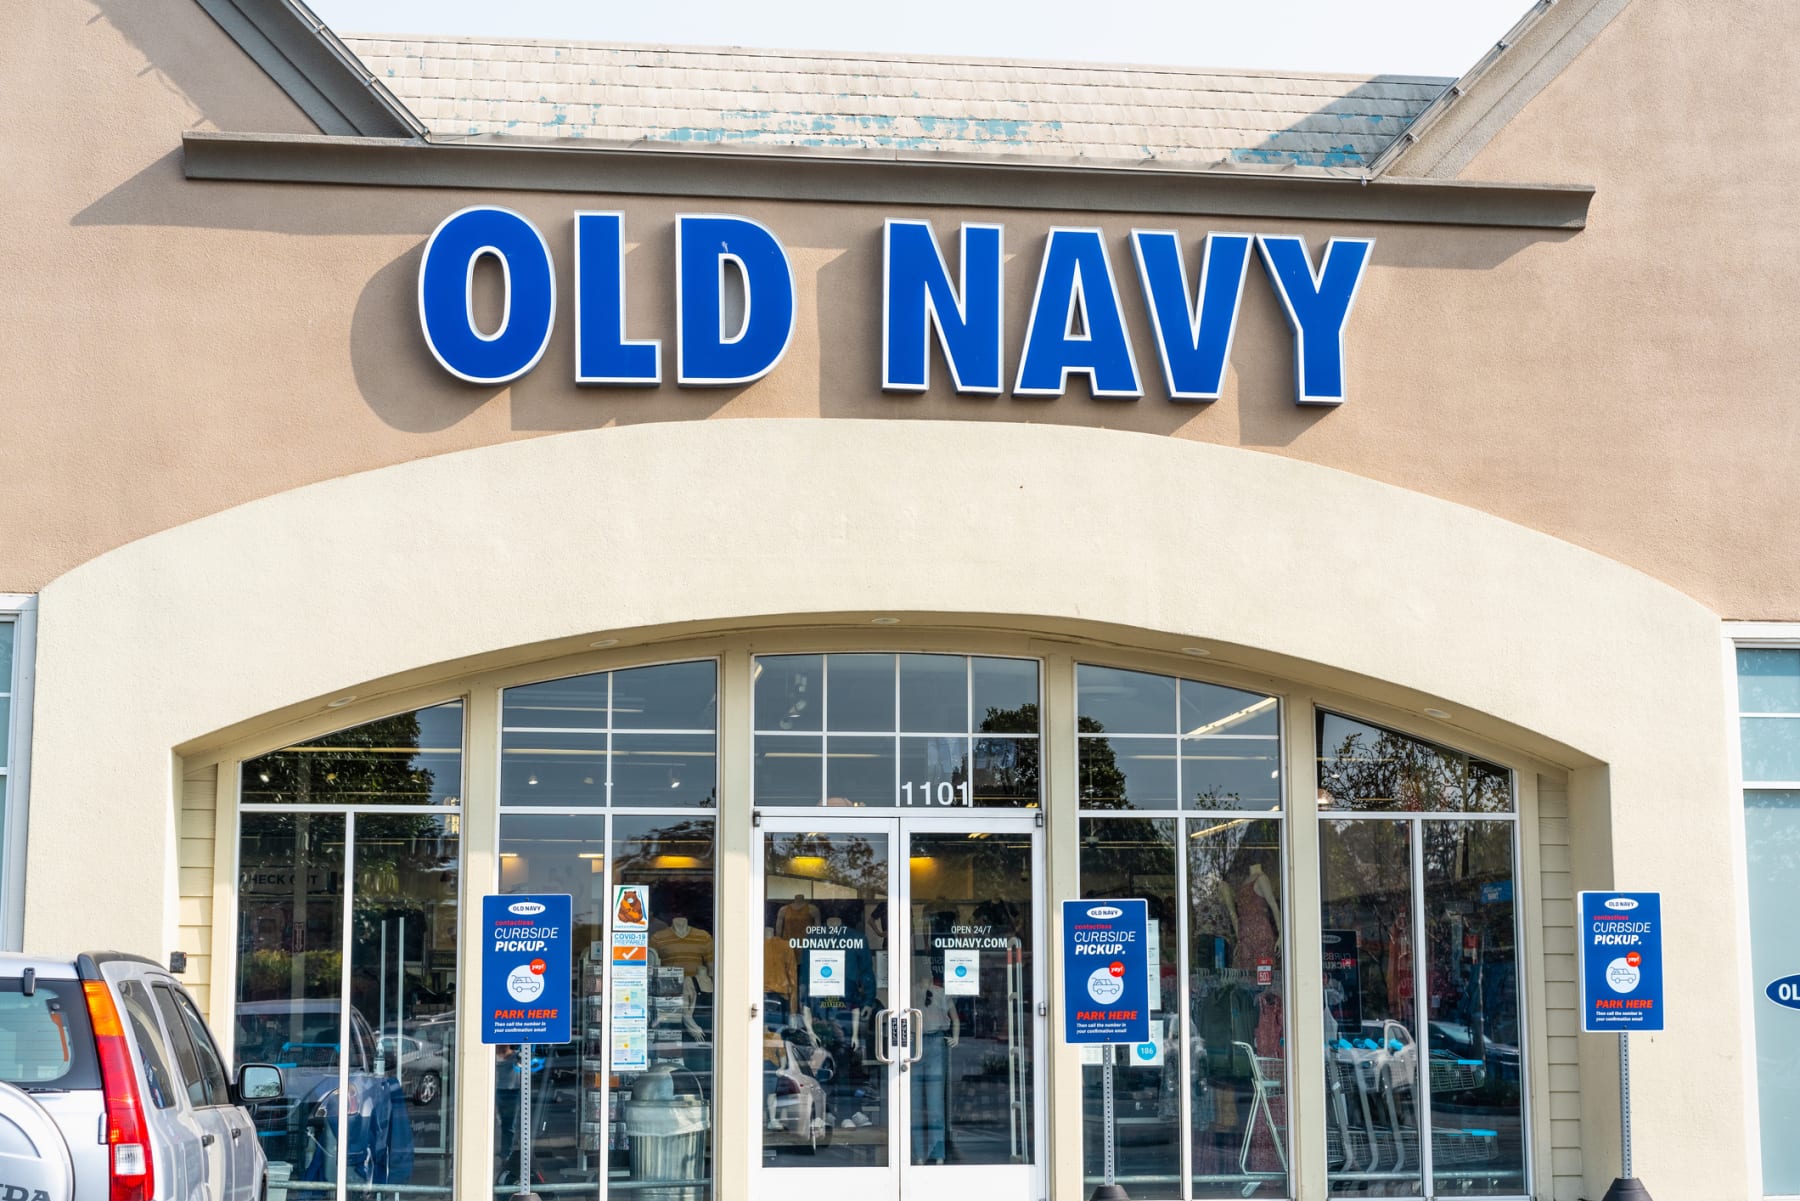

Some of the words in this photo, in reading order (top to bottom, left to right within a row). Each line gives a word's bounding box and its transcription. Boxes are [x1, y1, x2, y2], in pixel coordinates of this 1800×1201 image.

[418, 204, 797, 388] OLD
[882, 218, 1376, 406] NAVY
[902, 781, 968, 806] 1101
[806, 926, 826, 934] OPEN
[828, 926, 847, 935] 24/7
[951, 926, 971, 934] OPEN
[973, 926, 992, 935] 24/7
[1593, 922, 1651, 933] CURBSIDE
[494, 928, 559, 939] CURBSIDE
[1074, 931, 1136, 942] CURBSIDE
[789, 938, 863, 949] OLDNAVY.COM
[935, 938, 1007, 948] OLDNAVY.COM
[1594, 935, 1642, 945] PICKUP.
[495, 941, 548, 952] PICKUP.
[1075, 944, 1126, 955] PICKUP.
[1596, 1000, 1623, 1008] PARK
[1626, 1000, 1653, 1008] HERE
[494, 1010, 525, 1019] PARK
[528, 1009, 558, 1018] HERE
[1076, 1011, 1105, 1020] PARK
[1108, 1011, 1137, 1020] HERE
